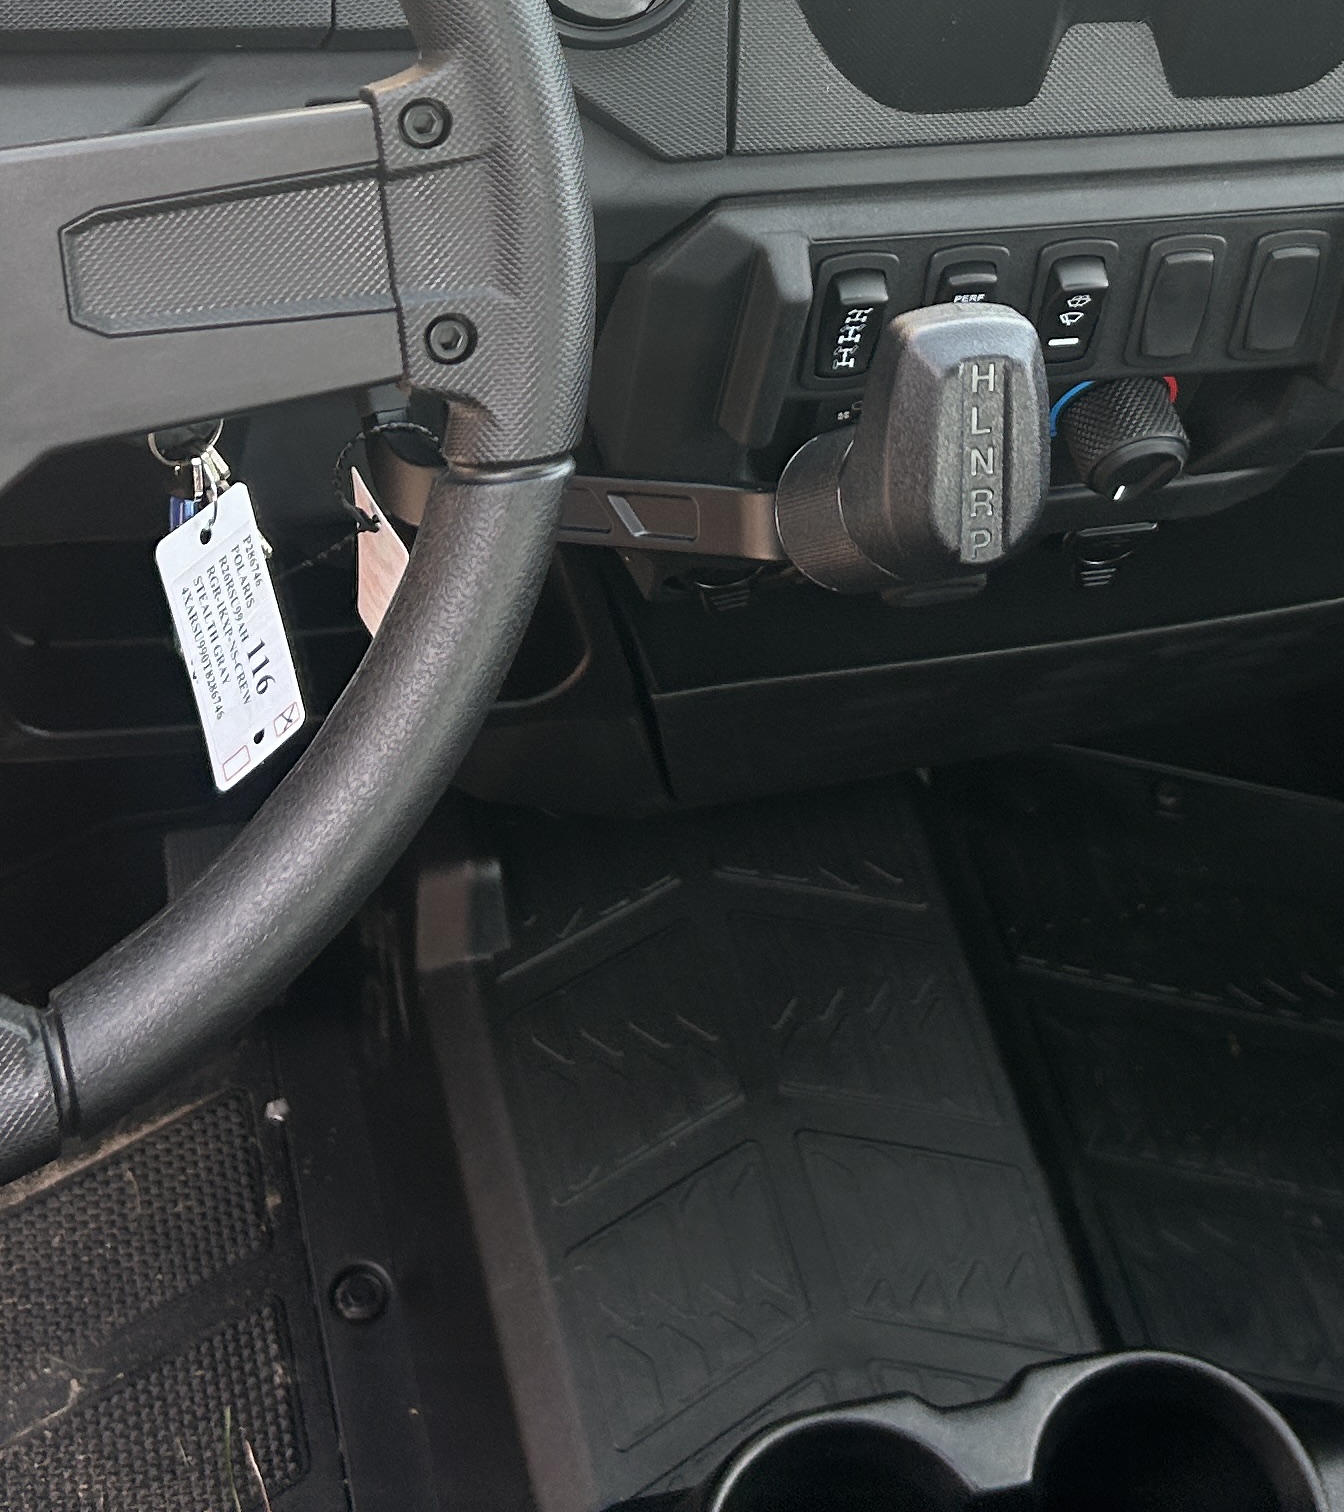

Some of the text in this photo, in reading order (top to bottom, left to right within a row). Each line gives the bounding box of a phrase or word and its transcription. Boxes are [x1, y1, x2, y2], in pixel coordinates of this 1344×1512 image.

[232, 544, 256, 609] POLARIS
[194, 576, 231, 684] STEALTH GRAY
[247, 638, 276, 695] 116
